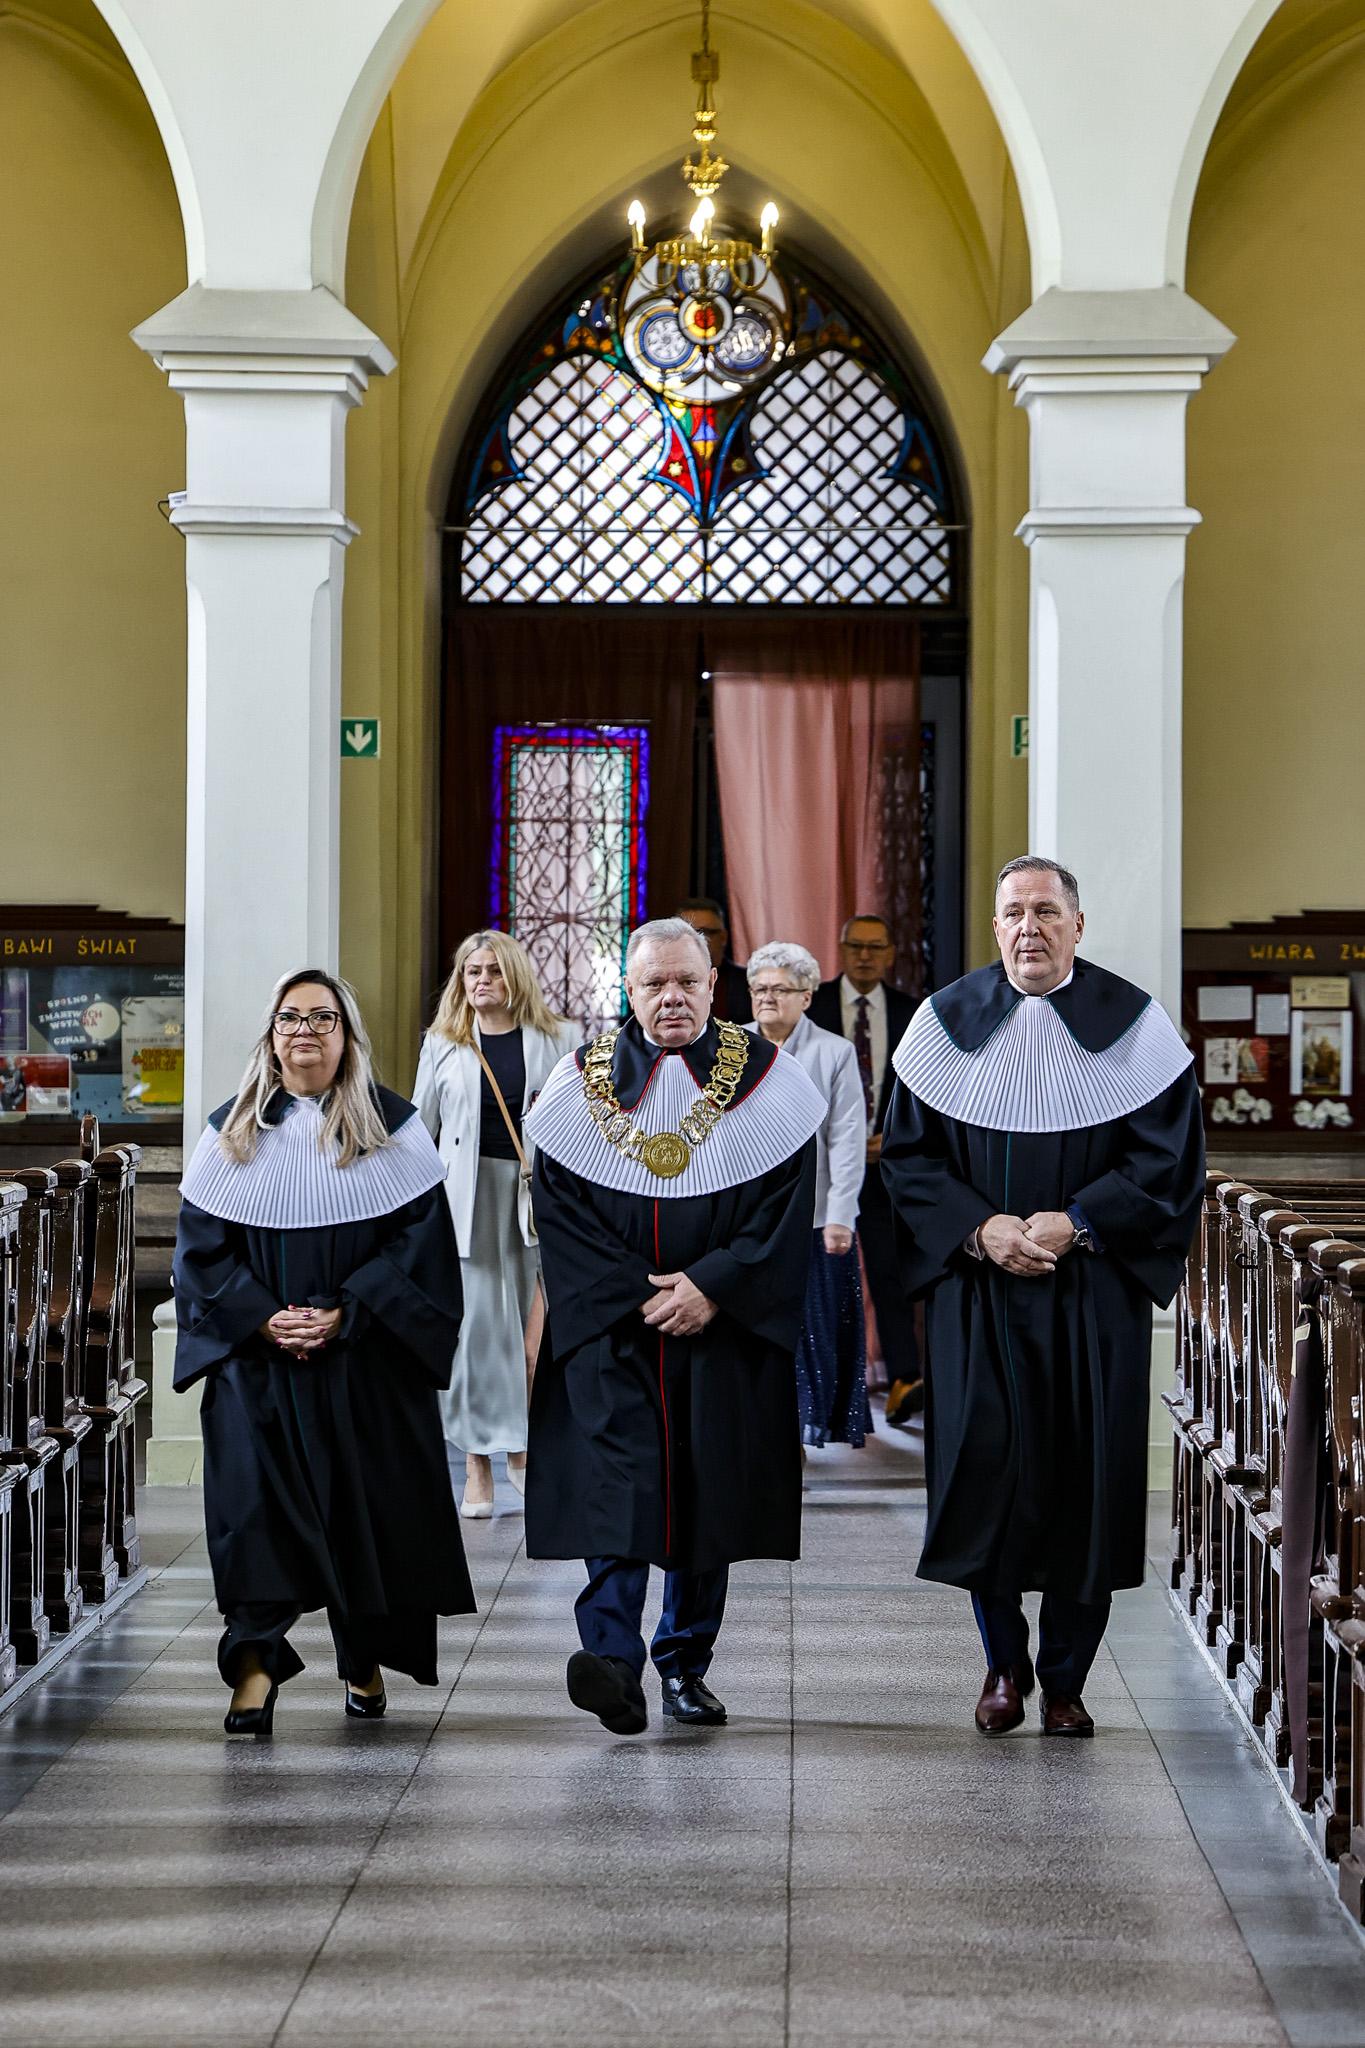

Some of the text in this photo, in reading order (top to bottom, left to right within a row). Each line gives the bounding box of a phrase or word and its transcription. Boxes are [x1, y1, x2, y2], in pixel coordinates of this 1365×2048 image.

[4, 935, 136, 954] BAWI ŚWIAT
[1249, 944, 1315, 959] WIARA
